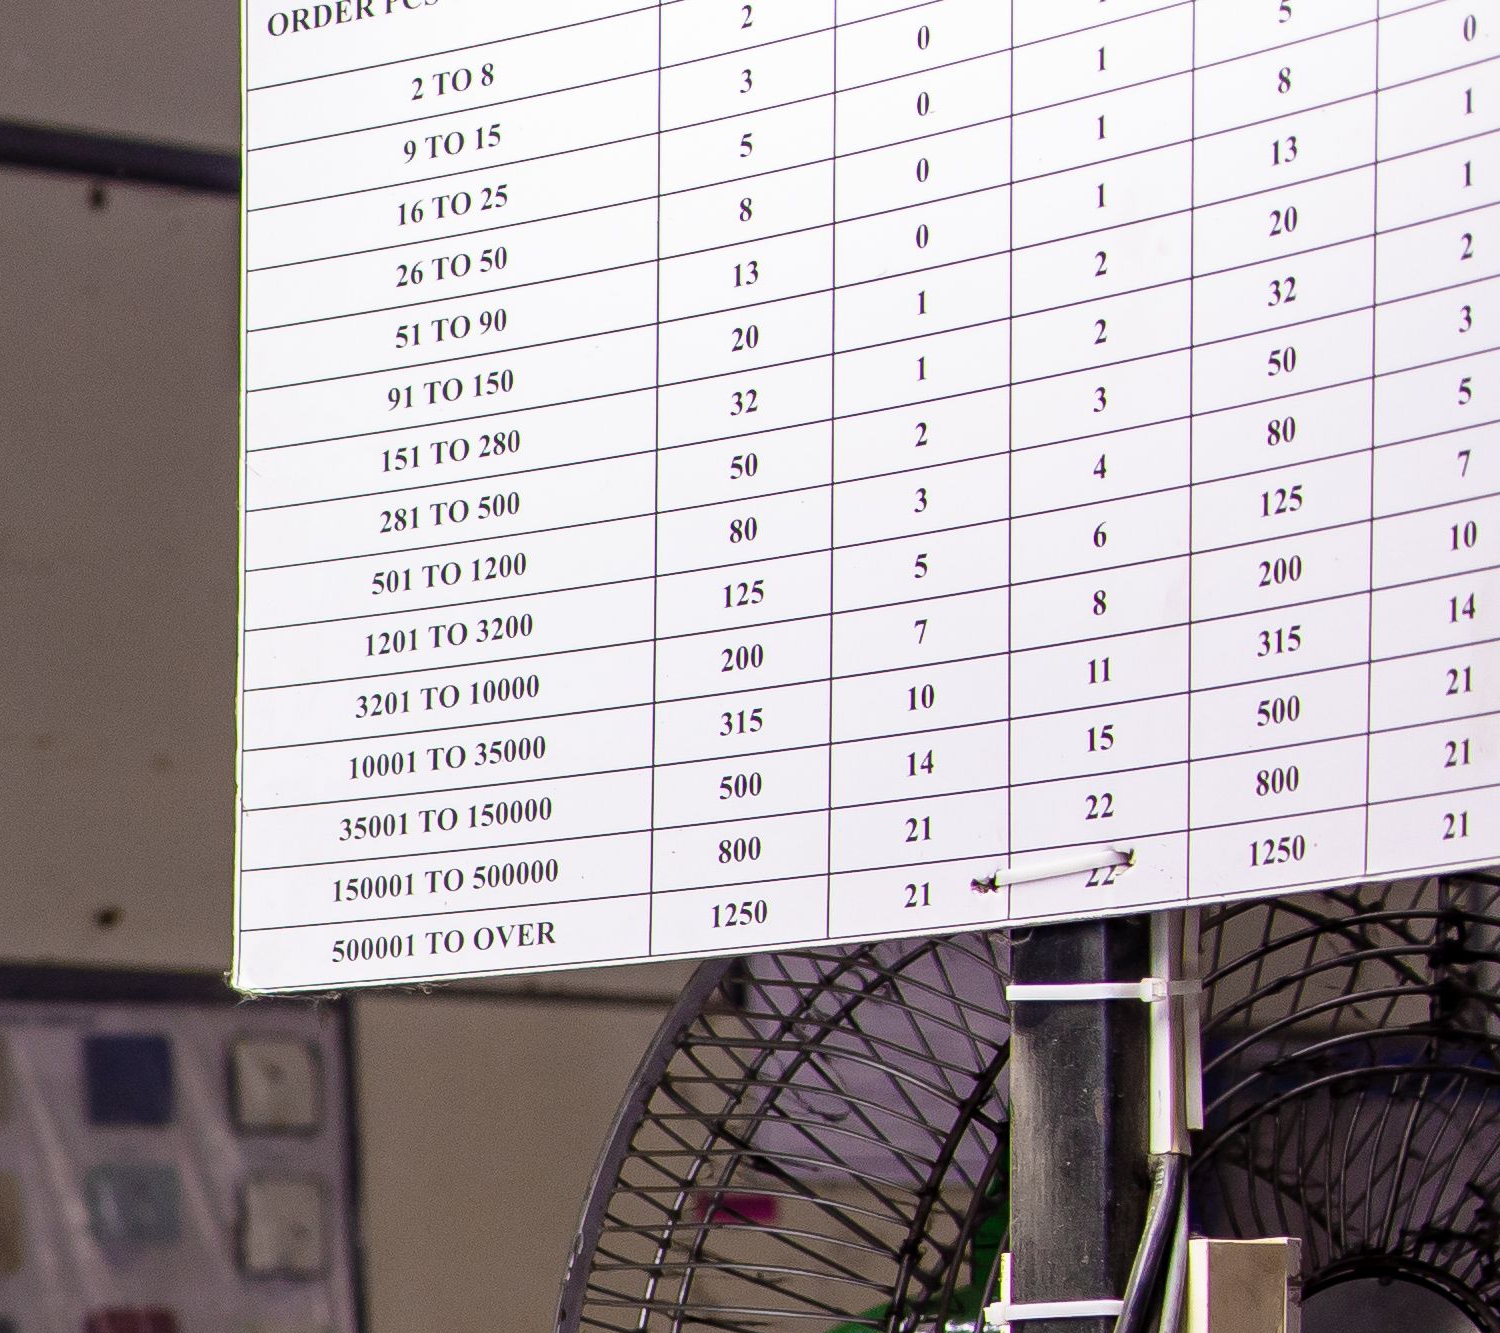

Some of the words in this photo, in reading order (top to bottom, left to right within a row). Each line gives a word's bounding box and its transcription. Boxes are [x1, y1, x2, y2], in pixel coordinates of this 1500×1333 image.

[267, 0, 375, 37] ORDER
[398, 199, 424, 227] 16
[431, 191, 472, 220] TO
[480, 183, 508, 211] 25
[740, 132, 753, 154] 5
[916, 91, 930, 117] 0
[1097, 46, 1106, 72] 1
[1278, 0, 1293, 23] 5
[403, 139, 417, 164] 9
[424, 131, 465, 159] TO
[475, 123, 501, 151] 15
[739, 68, 753, 94] 3
[917, 25, 931, 51] 0
[411, 77, 424, 101] 2
[432, 68, 473, 96] TO
[481, 62, 494, 87] 8
[740, 4, 754, 30] 2
[395, 260, 424, 288] 26
[431, 253, 472, 281] TO
[479, 246, 508, 273] 50
[739, 197, 753, 222] 8
[916, 157, 930, 183] 0
[1097, 114, 1106, 141] 1
[1277, 66, 1292, 94] 8
[1463, 14, 1477, 42] 0
[395, 322, 421, 347] 51
[430, 315, 471, 343] TO
[479, 308, 507, 335] 90
[733, 260, 759, 288] 13
[915, 223, 929, 249] 0
[1097, 182, 1105, 209] 1
[1272, 135, 1298, 166] 13
[1464, 87, 1473, 115] 1
[382, 445, 419, 473] 151
[429, 438, 470, 465] TO
[478, 429, 521, 458] 280
[729, 388, 758, 417] 32
[916, 355, 927, 382] 1
[1093, 318, 1108, 345] 2
[1267, 276, 1297, 307] 32
[1460, 232, 1473, 261] 2
[387, 385, 413, 411] 91
[423, 377, 464, 405] TO
[473, 368, 514, 398] 150
[731, 324, 759, 353] 20
[917, 290, 927, 316] 1
[1094, 250, 1108, 278] 2
[1269, 205, 1298, 237] 20
[1464, 160, 1472, 188] 1
[371, 567, 411, 596] 501
[421, 561, 462, 589] TO
[471, 552, 527, 582] 1200
[729, 516, 758, 544] 80
[913, 487, 928, 514] 3
[1092, 453, 1107, 480] 4
[1267, 416, 1296, 447] 80
[1458, 376, 1472, 401] 5
[379, 506, 419, 534] 281
[429, 499, 470, 527] TO
[477, 491, 520, 520] 500
[729, 452, 759, 480] 50
[915, 421, 928, 448] 2
[1092, 386, 1107, 413] 3
[1267, 346, 1297, 373] 50
[1461, 304, 1473, 330] 3
[355, 690, 410, 719] 3201
[419, 684, 460, 711] TO
[470, 674, 540, 705] 10000
[721, 643, 764, 673] 200
[914, 618, 928, 645] 7
[1092, 589, 1107, 616] 8
[1258, 554, 1302, 588] 200
[1450, 520, 1478, 551] 10
[366, 628, 418, 657] 1201
[427, 622, 468, 649] TO
[475, 613, 533, 643] 3200
[723, 579, 765, 609] 125
[914, 552, 928, 579] 5
[1093, 521, 1107, 548] 6
[1261, 484, 1303, 518] 125
[1457, 449, 1471, 477] 7
[338, 812, 408, 842] 35001
[418, 807, 459, 833] TO
[468, 796, 552, 829] 150000
[719, 771, 763, 801] 500
[907, 749, 935, 777] 14
[1087, 724, 1114, 753] 15
[1256, 694, 1301, 727] 500
[1445, 665, 1471, 696] 21
[349, 750, 416, 780] 10001
[426, 745, 467, 771] TO
[474, 735, 546, 767] 35000
[719, 707, 763, 737] 315
[907, 683, 935, 712] 10
[1087, 656, 1111, 685] 11
[1257, 624, 1301, 658] 315
[1449, 592, 1476, 623] 14
[331, 933, 414, 963] 500001
[424, 929, 465, 955] TO
[473, 919, 558, 951] OVER
[711, 900, 769, 930] 1250
[904, 883, 932, 910] 21
[1250, 834, 1306, 867] 1250
[1442, 810, 1468, 841] 21
[333, 873, 413, 903] 150001
[424, 868, 464, 894] TO
[472, 858, 559, 890] 500000
[718, 836, 762, 864] 800
[905, 815, 931, 843] 21
[1084, 792, 1114, 821] 22
[1255, 765, 1299, 797] 800
[1443, 737, 1470, 769] 21
